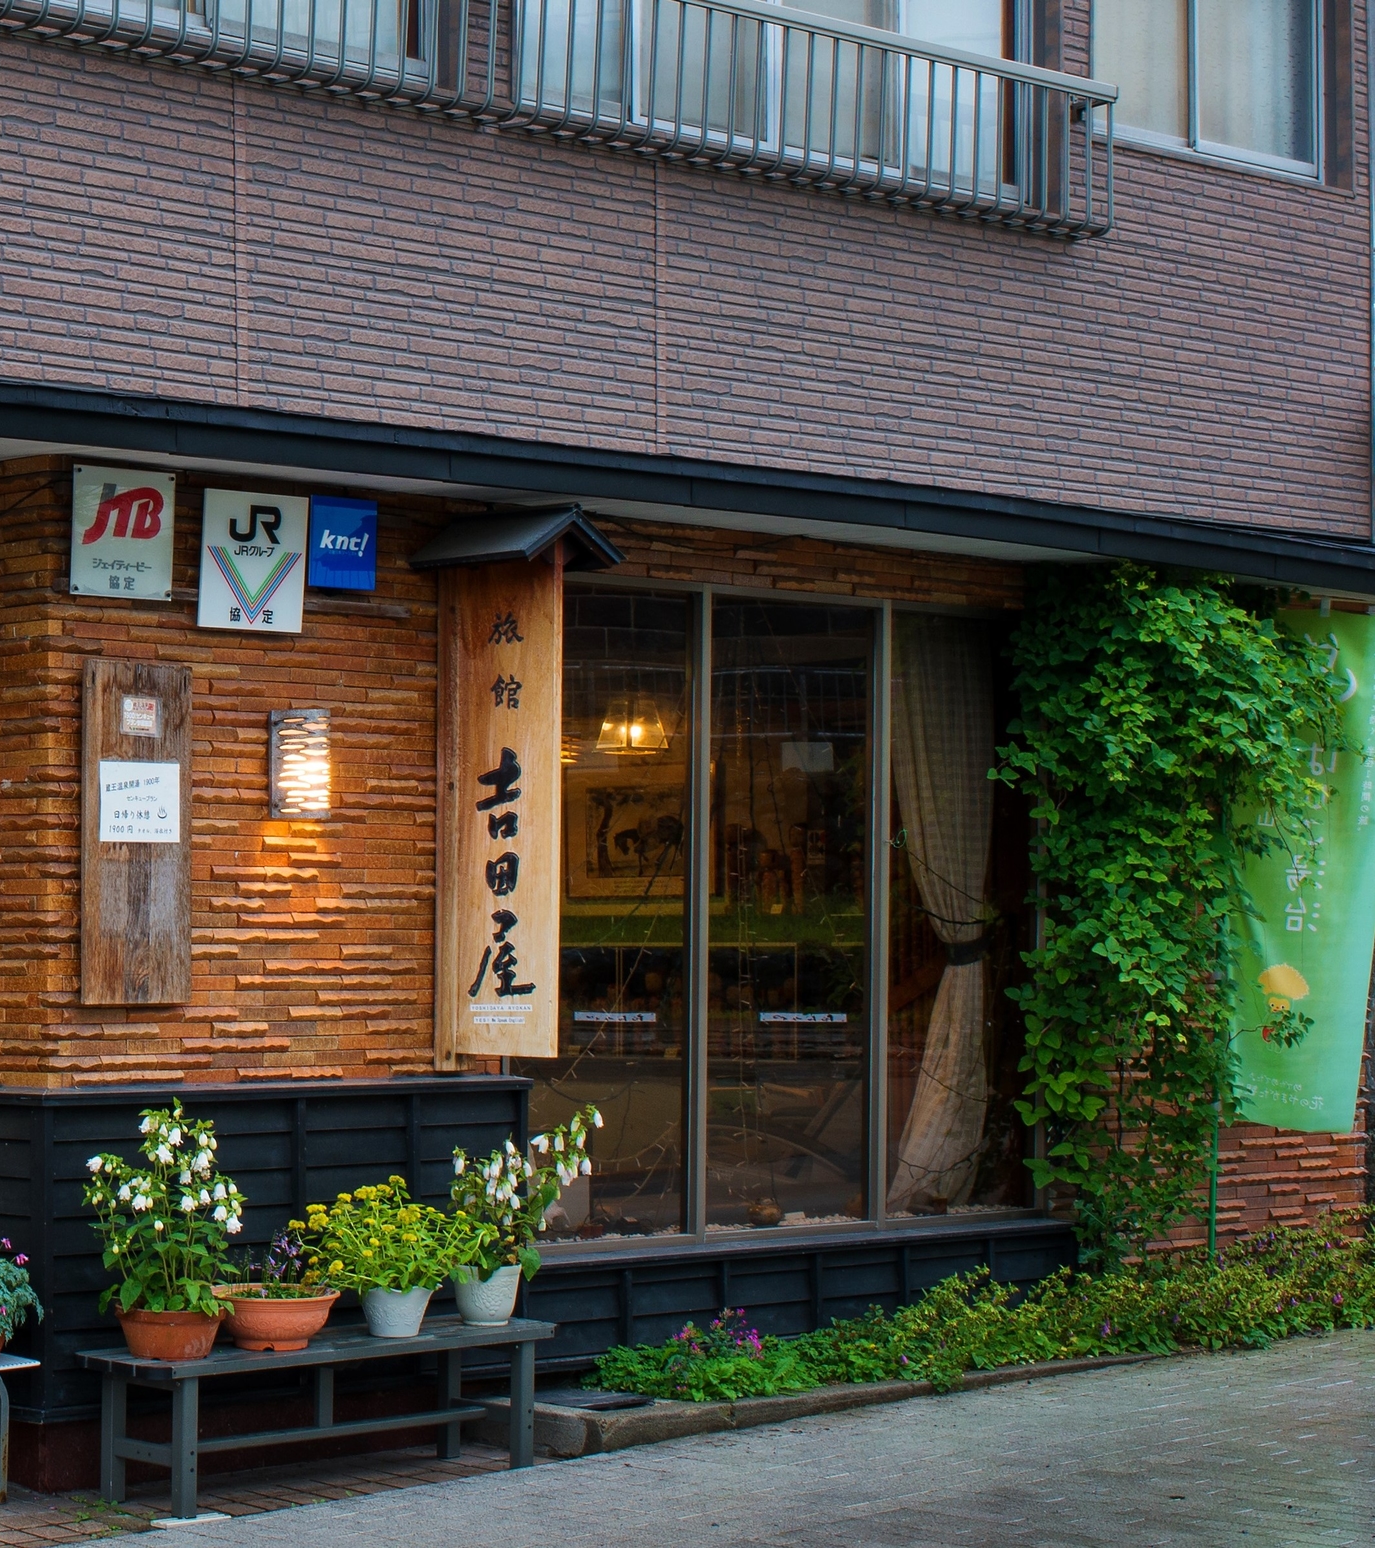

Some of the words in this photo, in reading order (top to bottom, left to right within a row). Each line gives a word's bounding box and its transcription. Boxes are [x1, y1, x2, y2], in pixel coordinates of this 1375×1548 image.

[82, 482, 164, 545] JTB
[229, 504, 281, 544] JR
[319, 529, 369, 557] knt!
[234, 544, 275, 557] JRグループ
[92, 558, 152, 572] ジェイティービー
[109, 575, 135, 590] 協定
[106, 779, 140, 792] 蔵王温泉開湯
[113, 809, 151, 820] 日帰り休憩
